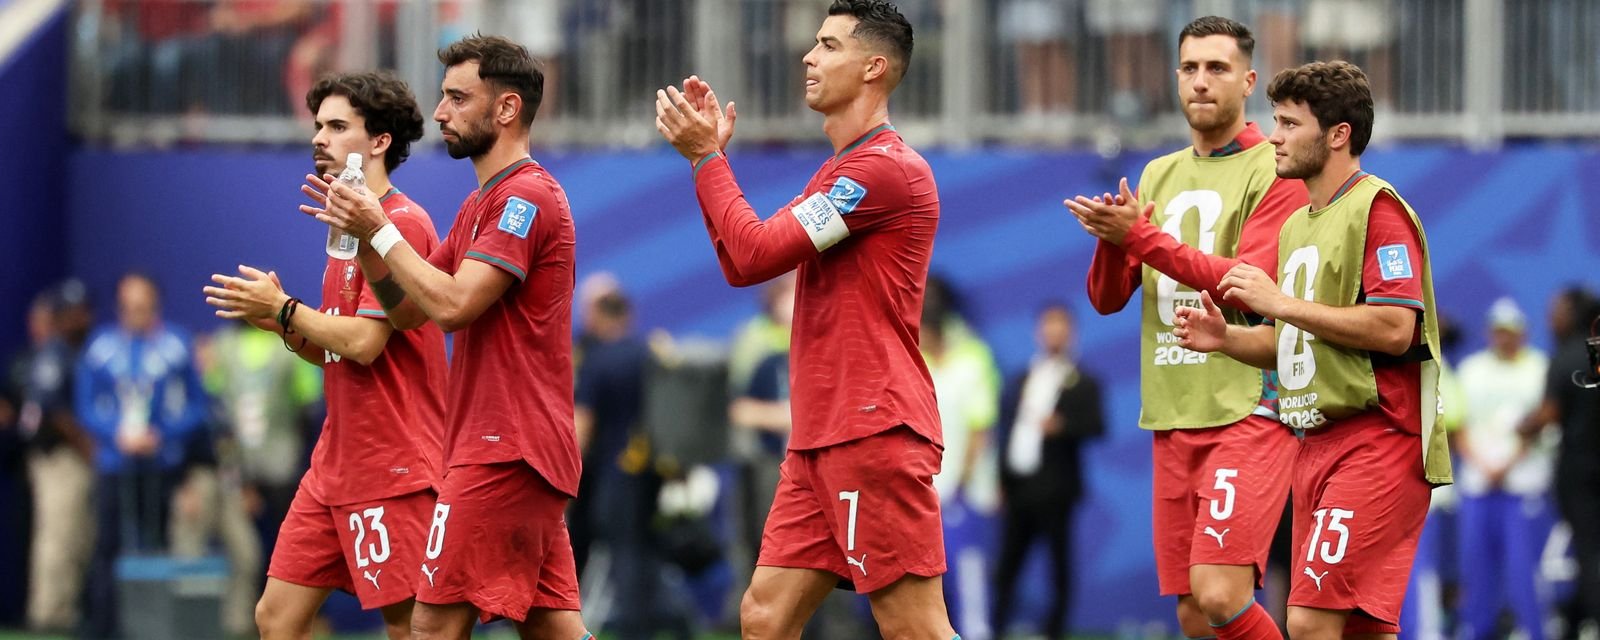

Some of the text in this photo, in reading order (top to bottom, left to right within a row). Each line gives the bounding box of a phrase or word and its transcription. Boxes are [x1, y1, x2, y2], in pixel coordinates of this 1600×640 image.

[807, 197, 830, 225] UNITES
[838, 489, 860, 551] 7
[1210, 468, 1238, 520] 5
[349, 505, 391, 568] 23
[426, 502, 451, 560] 8
[1306, 508, 1354, 564] 15
